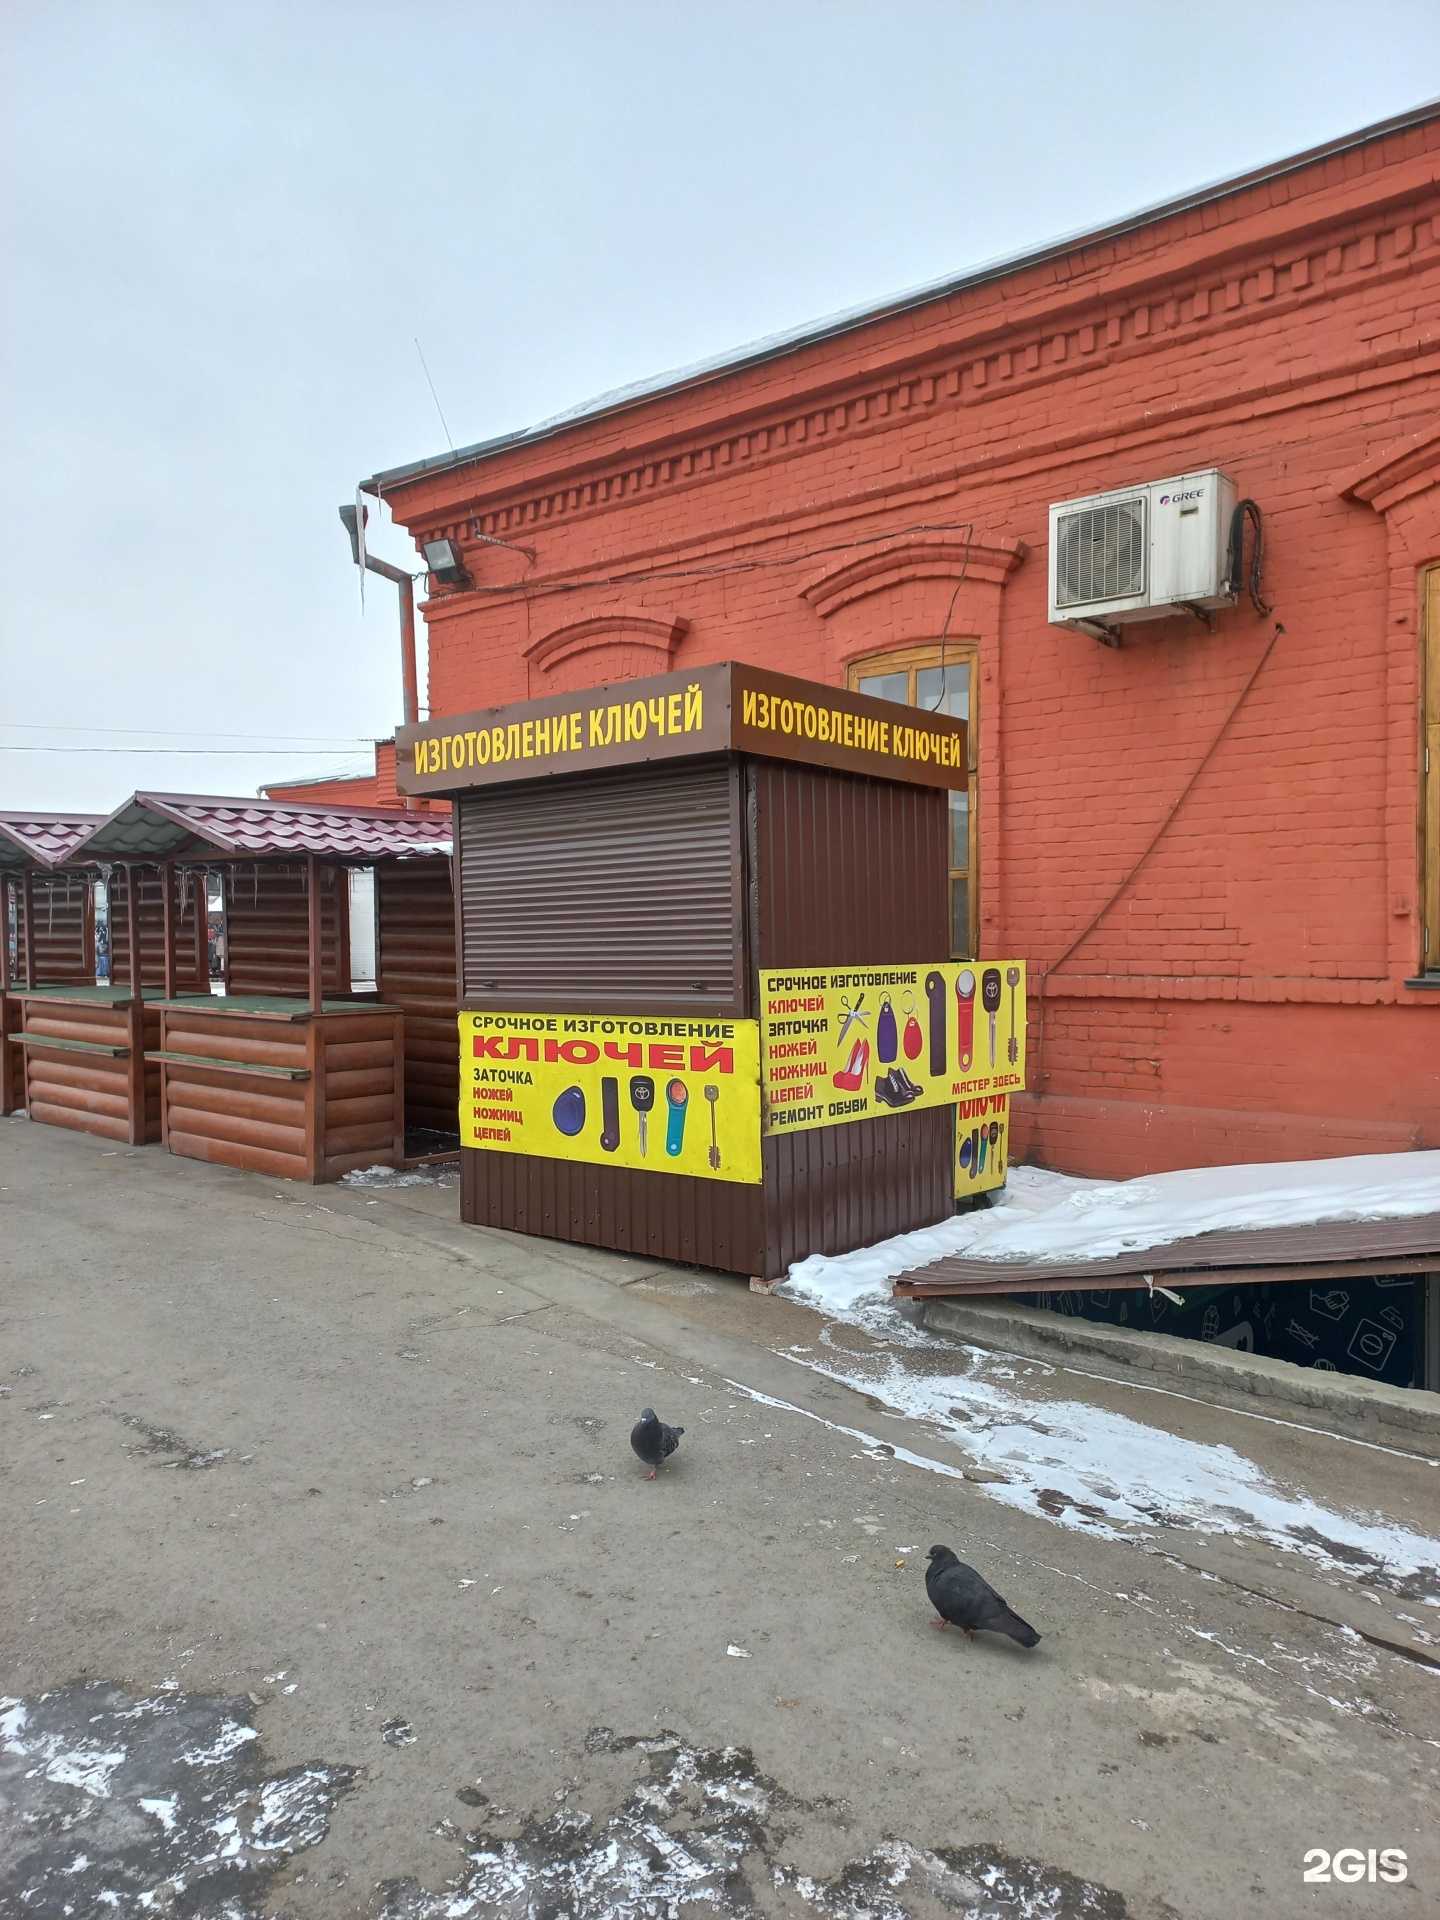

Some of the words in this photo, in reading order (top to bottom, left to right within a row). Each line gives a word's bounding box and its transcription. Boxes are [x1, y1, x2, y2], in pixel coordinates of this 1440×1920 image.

[1172, 488, 1205, 503] GREE
[414, 711, 583, 775] ИЗГОТОВЛЕНИЕ
[588, 684, 703, 747] КЛЮЧЕЙ
[742, 689, 889, 752] ИЗГОТОВЛЕНИЕ
[892, 727, 961, 768] КЛЮЧЕЙ
[767, 974, 827, 992] СРОЧНОЕ
[831, 971, 917, 989] ИЗГОТОВЛЕНИЕ
[768, 995, 824, 1014] КЛЮЧЕЙ
[472, 1016, 557, 1031] СРОЧНОЕ
[563, 1019, 734, 1039] ИЗГОТОВЛЕНИЕ
[768, 1018, 828, 1037] ЗАТОЧКА
[472, 1035, 734, 1074] КЛЮЧЕЙ
[769, 1038, 817, 1059] НОЖЕЙ
[473, 1068, 533, 1085] ЗАТОЧКА
[769, 1062, 828, 1082] НОЖНИЦ
[472, 1086, 513, 1102] НОЖЕЙ
[770, 1082, 813, 1104] ЦЕПЕЙ
[951, 1079, 990, 1095] МАСТЕР
[993, 1075, 1021, 1088] ЗДЕСЬ
[473, 1106, 523, 1125] НОЖНИЦ
[770, 1104, 825, 1126] РЕМОНТ
[828, 1097, 868, 1116] ОБУВИ
[473, 1126, 511, 1142] ЦЕПЕЙ
